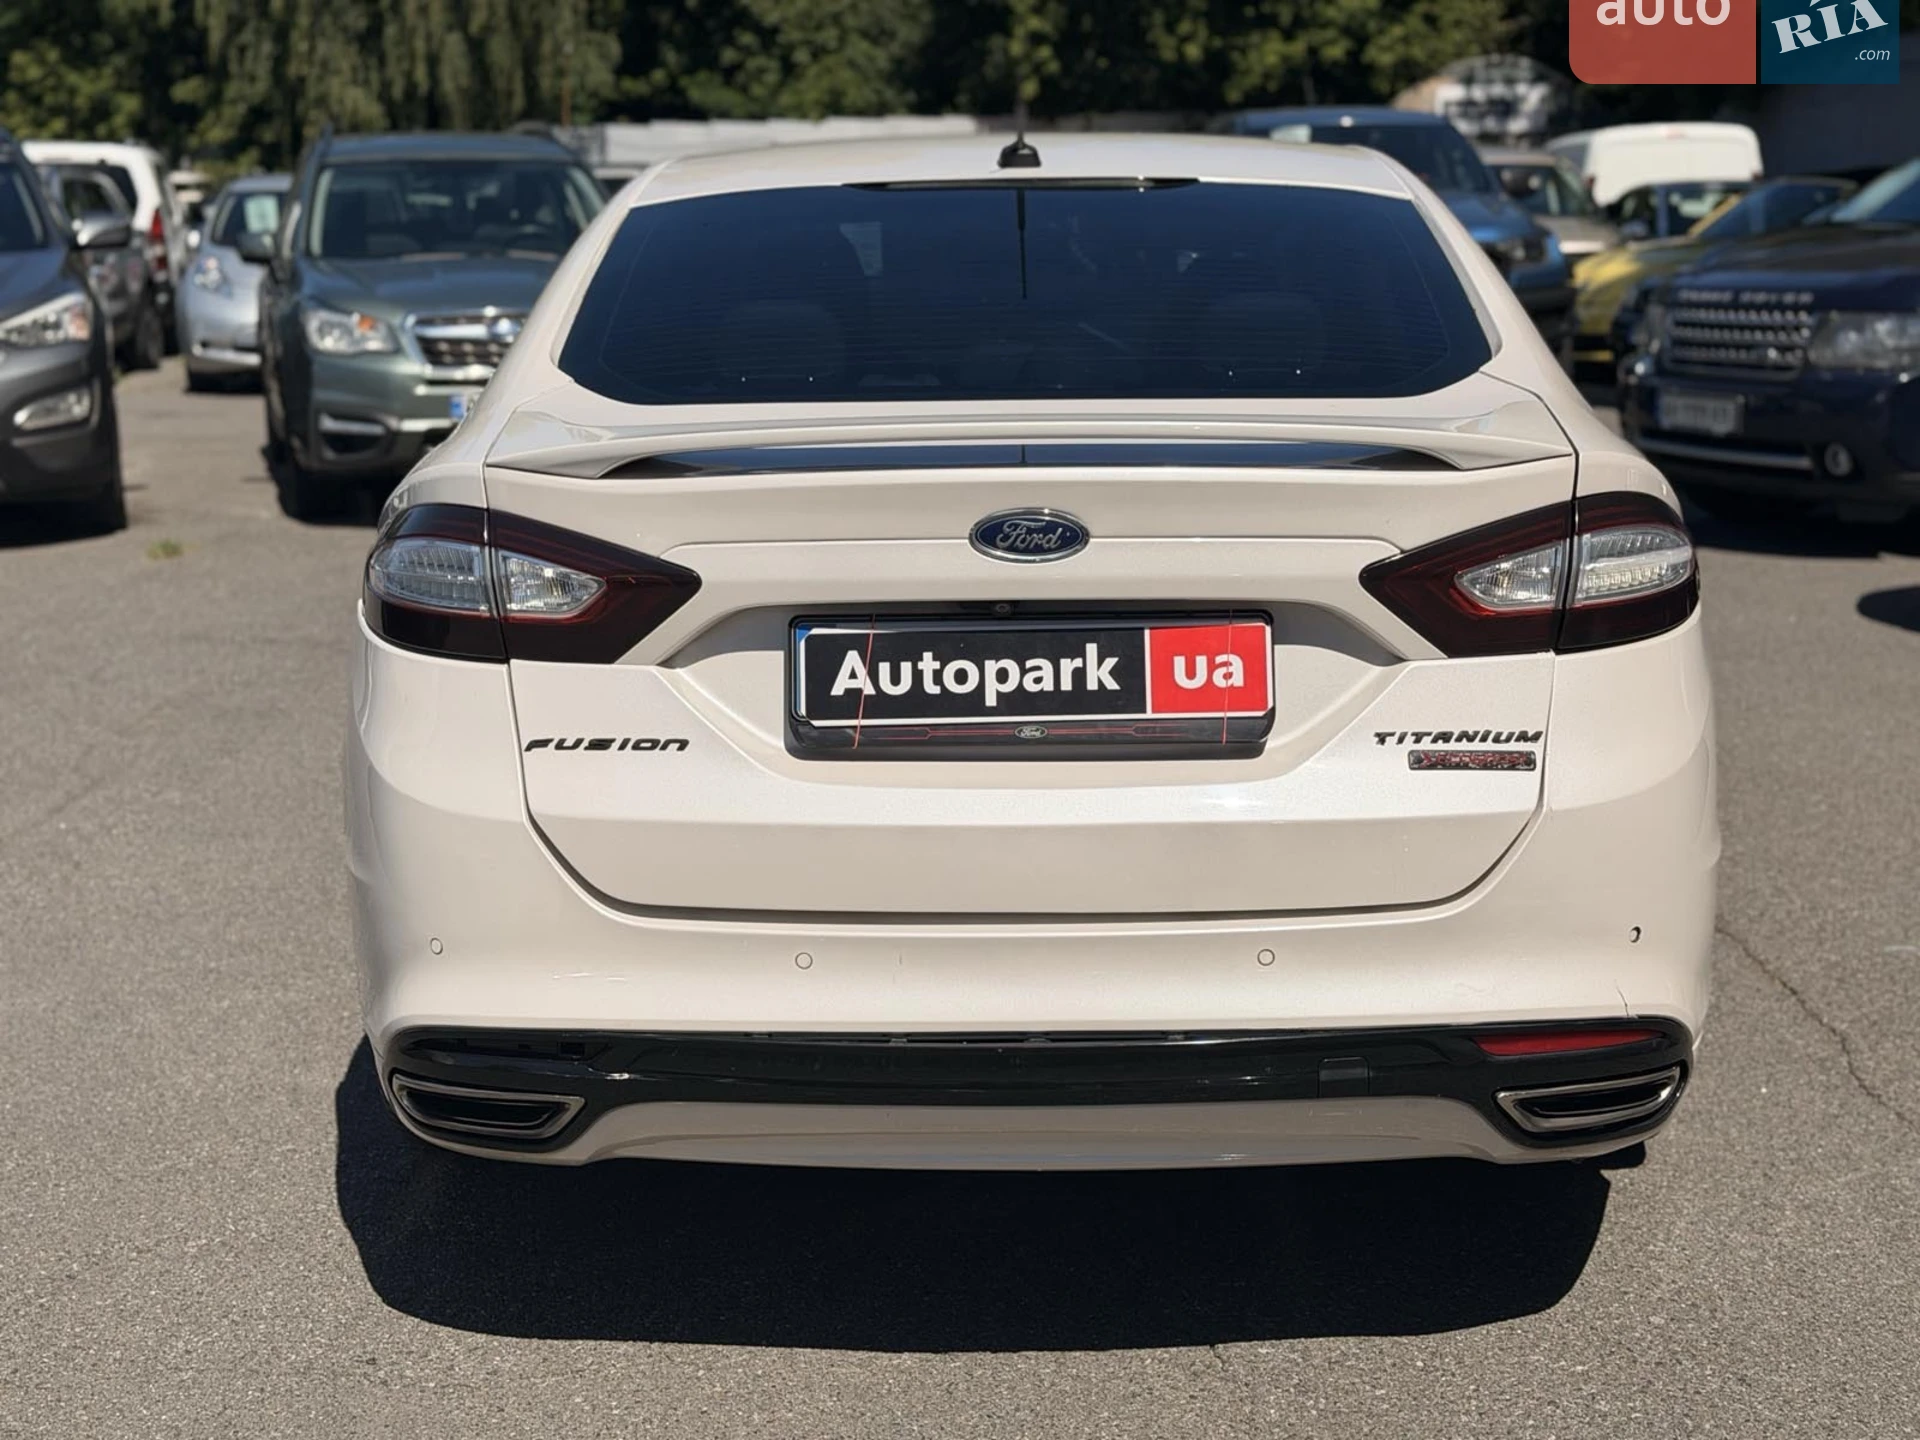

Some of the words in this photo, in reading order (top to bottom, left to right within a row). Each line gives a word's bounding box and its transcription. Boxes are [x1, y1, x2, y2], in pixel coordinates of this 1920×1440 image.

[996, 519, 1063, 549] Ford
[830, 643, 1121, 707] Autopark
[1172, 653, 1245, 689] ua
[524, 737, 690, 752] FUSION
[1373, 729, 1544, 746] TITANIUM
